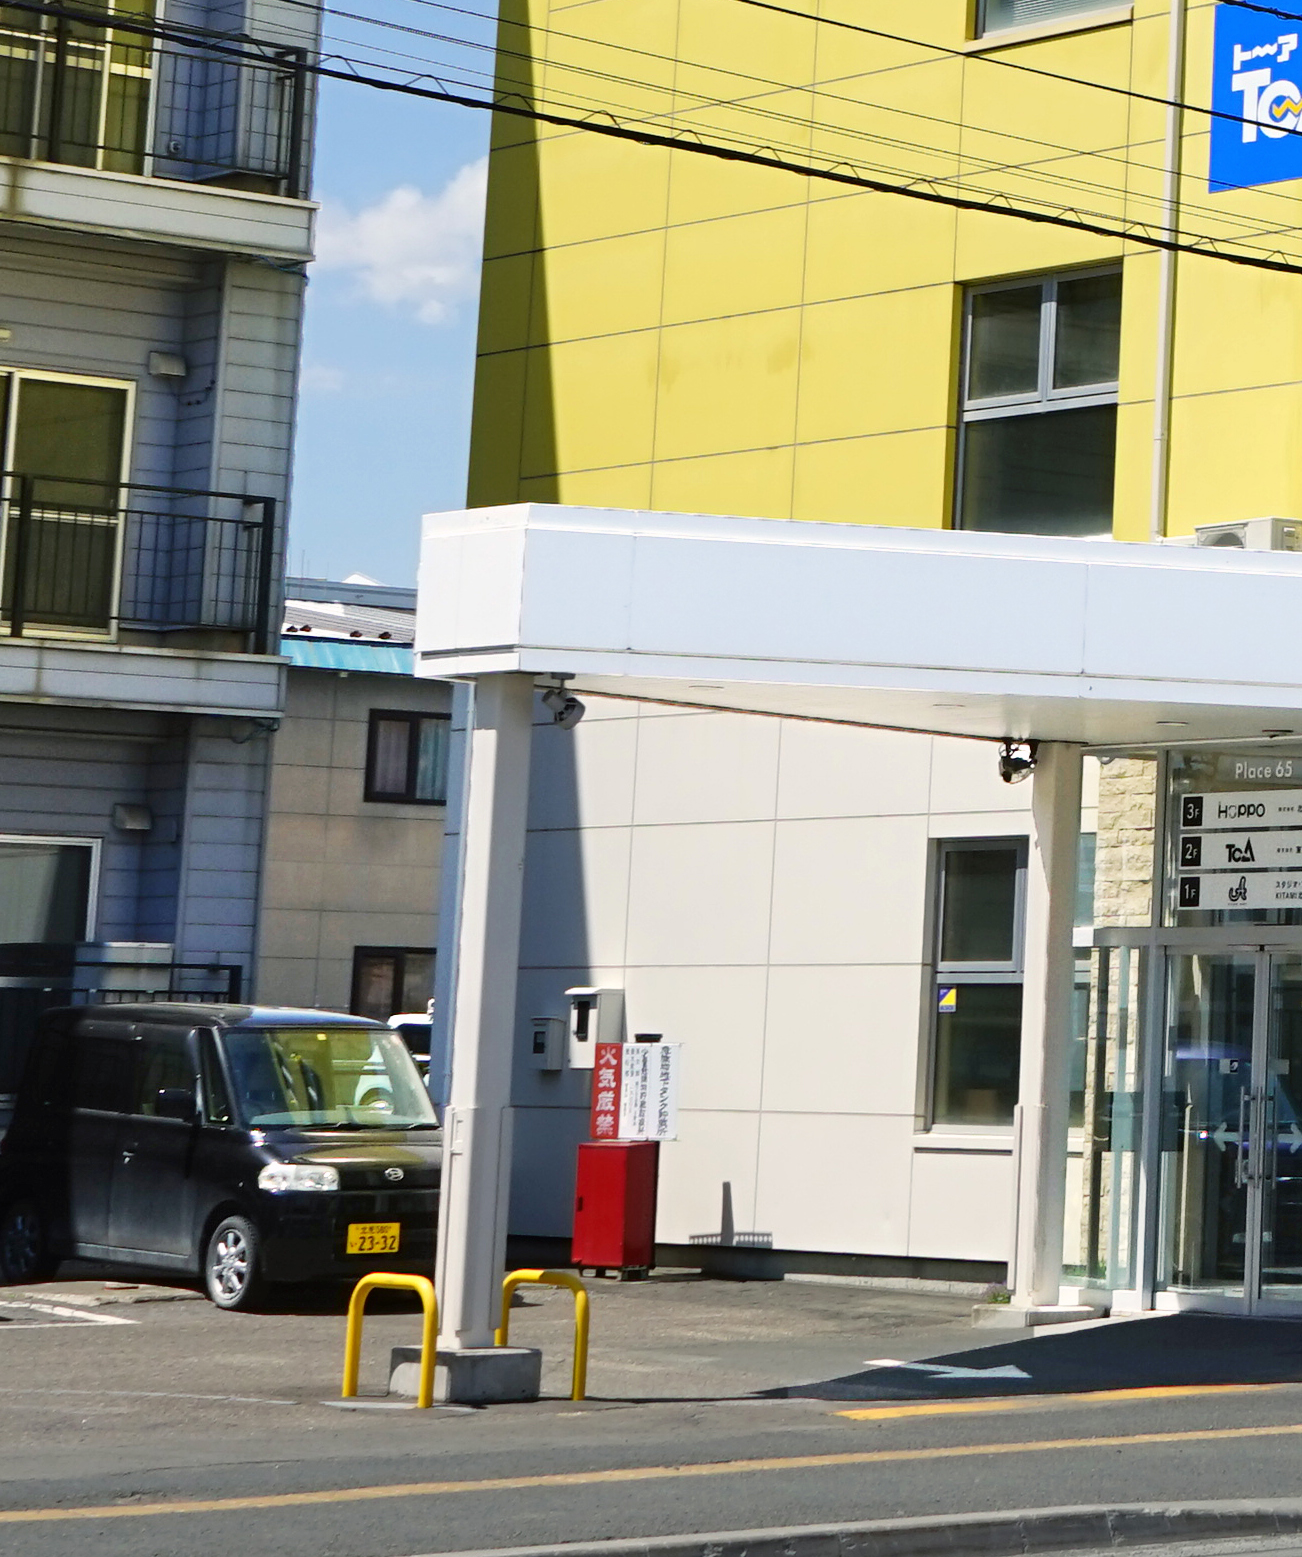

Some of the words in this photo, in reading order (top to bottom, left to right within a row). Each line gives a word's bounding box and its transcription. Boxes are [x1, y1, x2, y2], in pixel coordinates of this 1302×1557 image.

[1235, 762, 1272, 780] Place
[1275, 760, 1293, 778] 65
[1186, 803, 1200, 820] 3F
[1185, 843, 1198, 860] 2F
[1184, 884, 1197, 899] 1F
[596, 1046, 618, 1136] 火気厳禁
[358, 1235, 396, 1251] 23-32
